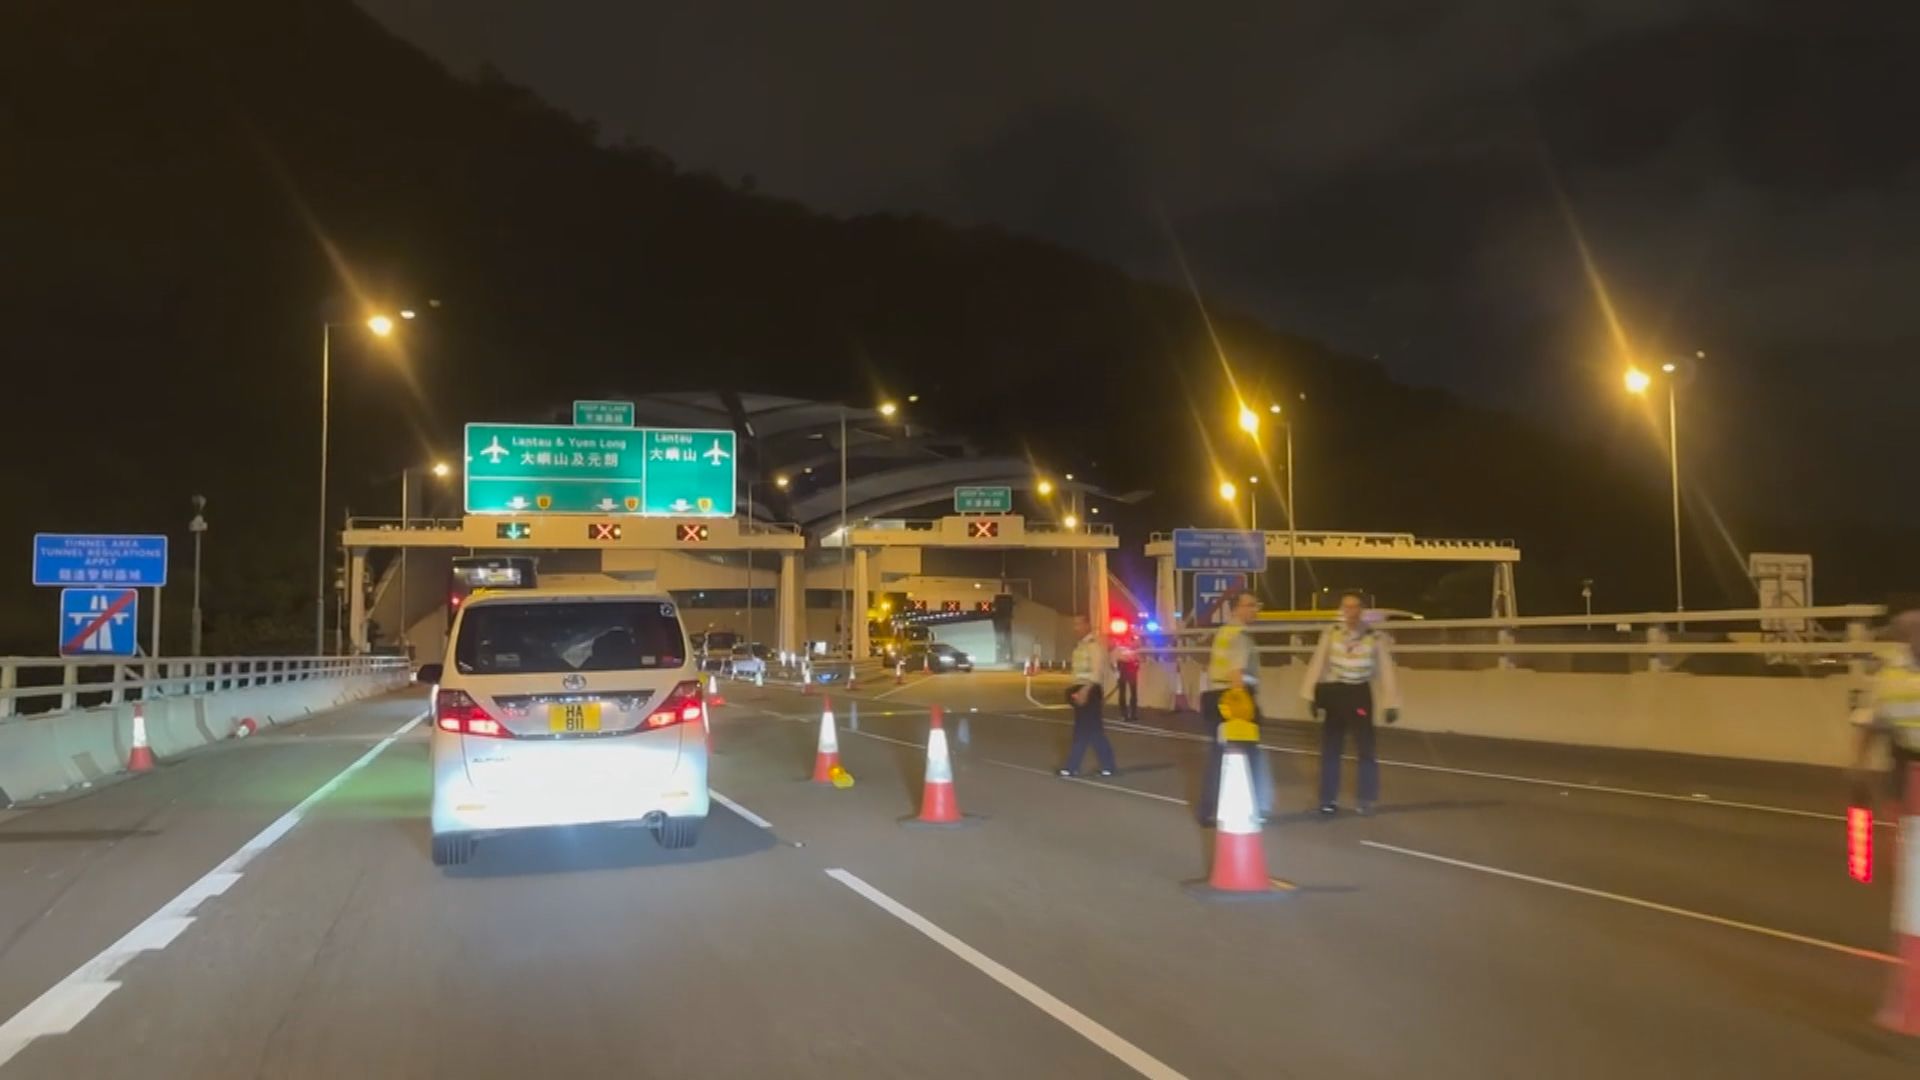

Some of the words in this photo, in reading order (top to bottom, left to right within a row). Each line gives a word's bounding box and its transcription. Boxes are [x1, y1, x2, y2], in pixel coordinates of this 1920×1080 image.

[512, 435, 552, 447] Lantau
[556, 436, 565, 447] &
[568, 437, 596, 448] Yuen
[600, 438, 626, 450] Long
[655, 432, 693, 444] Lantau
[650, 447, 697, 462] 大嶼山
[64, 539, 106, 547] TUNNEL
[111, 539, 139, 547] AREA
[41, 547, 83, 556] TUNNEL
[87, 548, 161, 557] REGULATIONS
[84, 557, 117, 566] APPLY
[565, 705, 584, 718] HA
